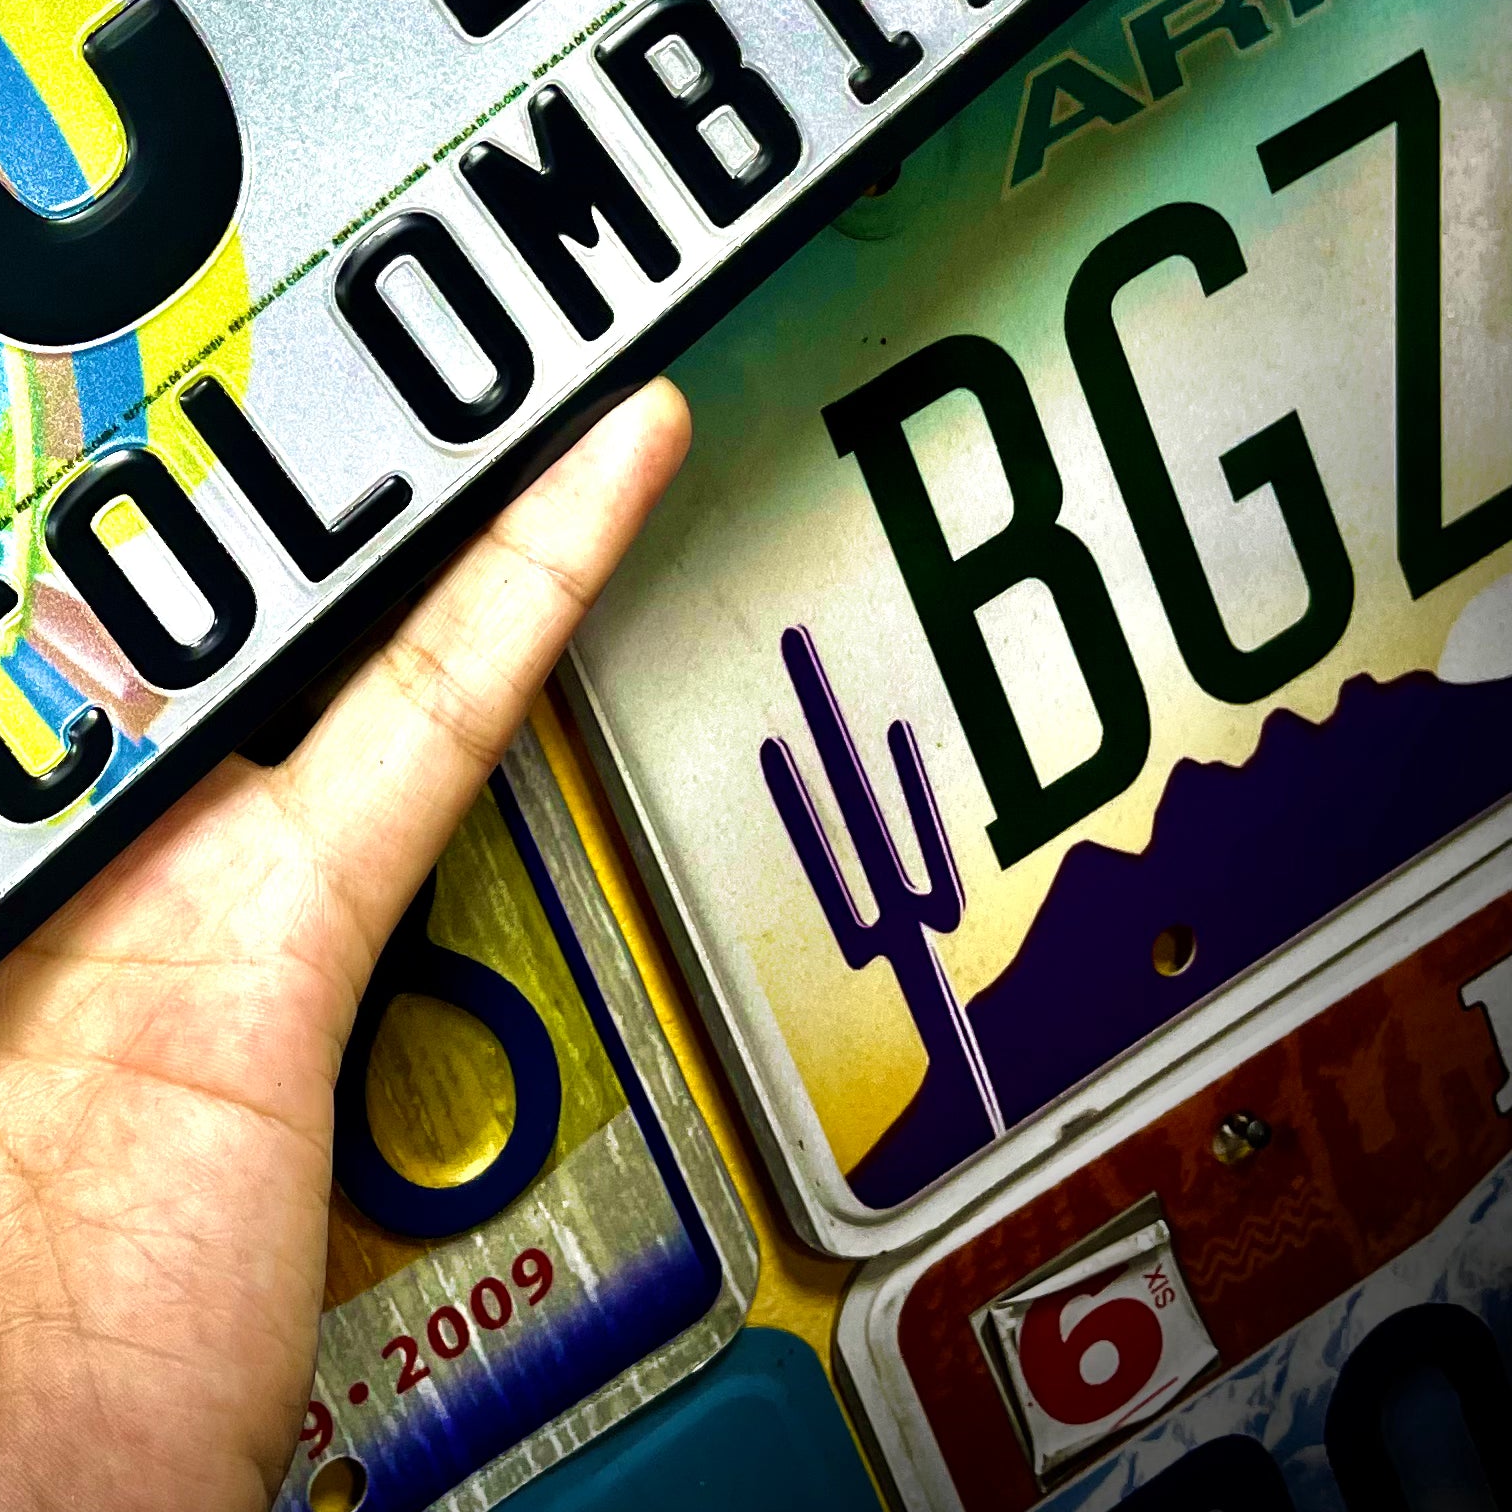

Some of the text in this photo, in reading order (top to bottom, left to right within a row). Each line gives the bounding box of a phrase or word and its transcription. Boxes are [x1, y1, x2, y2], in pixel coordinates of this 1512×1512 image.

[381, 1248, 554, 1395] 2009
[1019, 1262, 1164, 1425] 6
[1143, 1262, 1176, 1310] SIX
